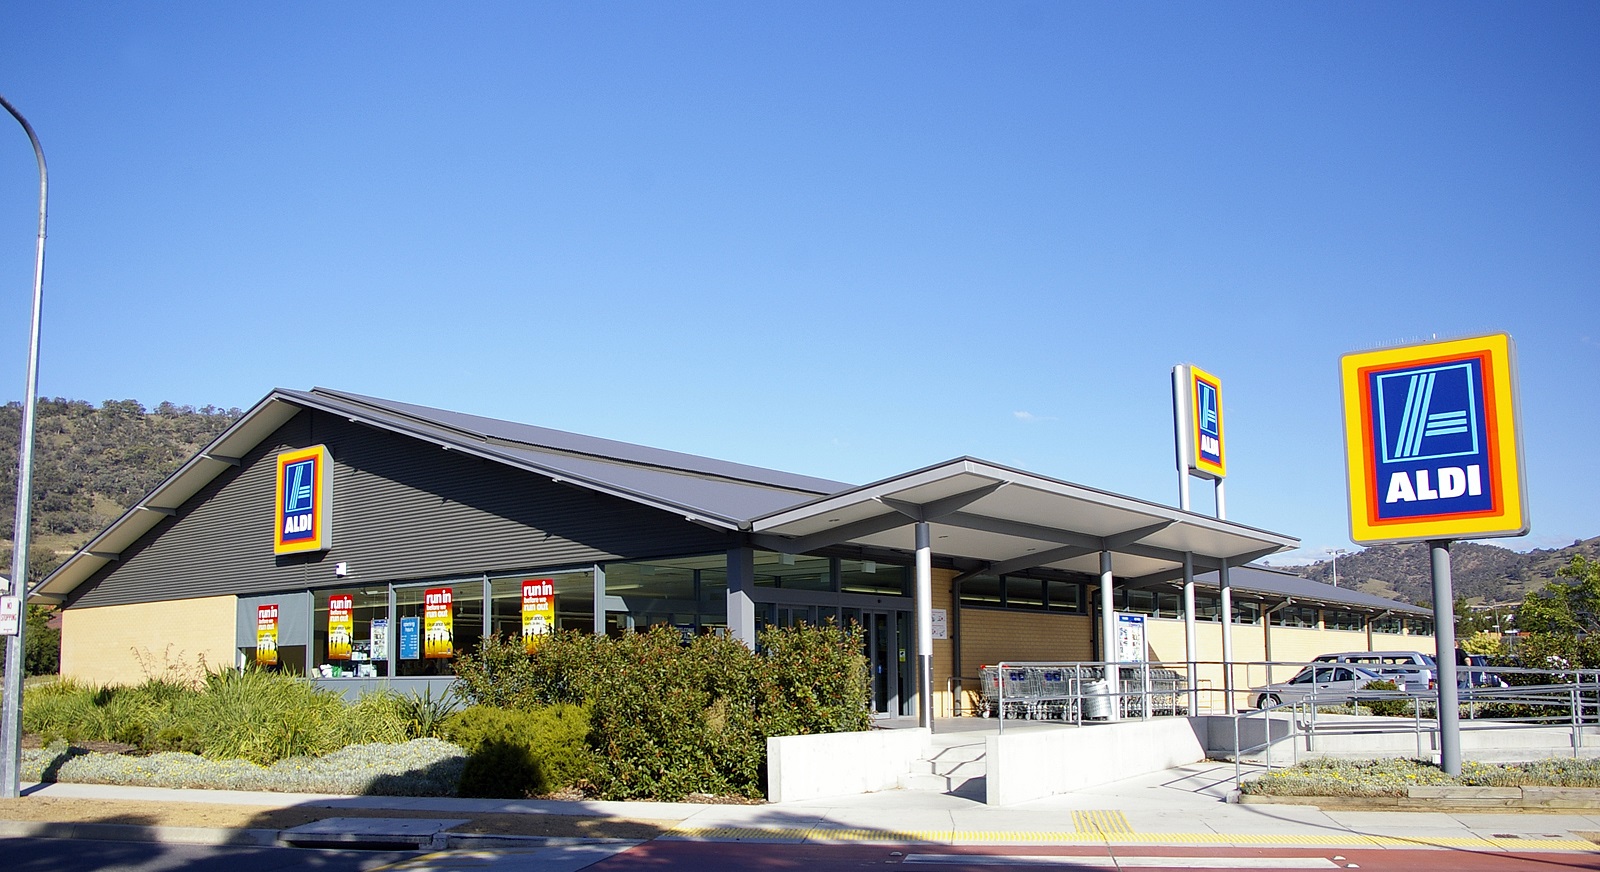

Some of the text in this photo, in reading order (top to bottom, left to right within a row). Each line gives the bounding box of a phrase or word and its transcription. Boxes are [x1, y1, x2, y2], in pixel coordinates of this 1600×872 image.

[1201, 434, 1219, 456] ALDI
[1386, 465, 1481, 504] ALDI
[285, 514, 312, 534] ALDI
[524, 581, 552, 596] run in
[330, 596, 352, 610] run in
[426, 590, 452, 604] run in
[259, 606, 277, 618] run in
